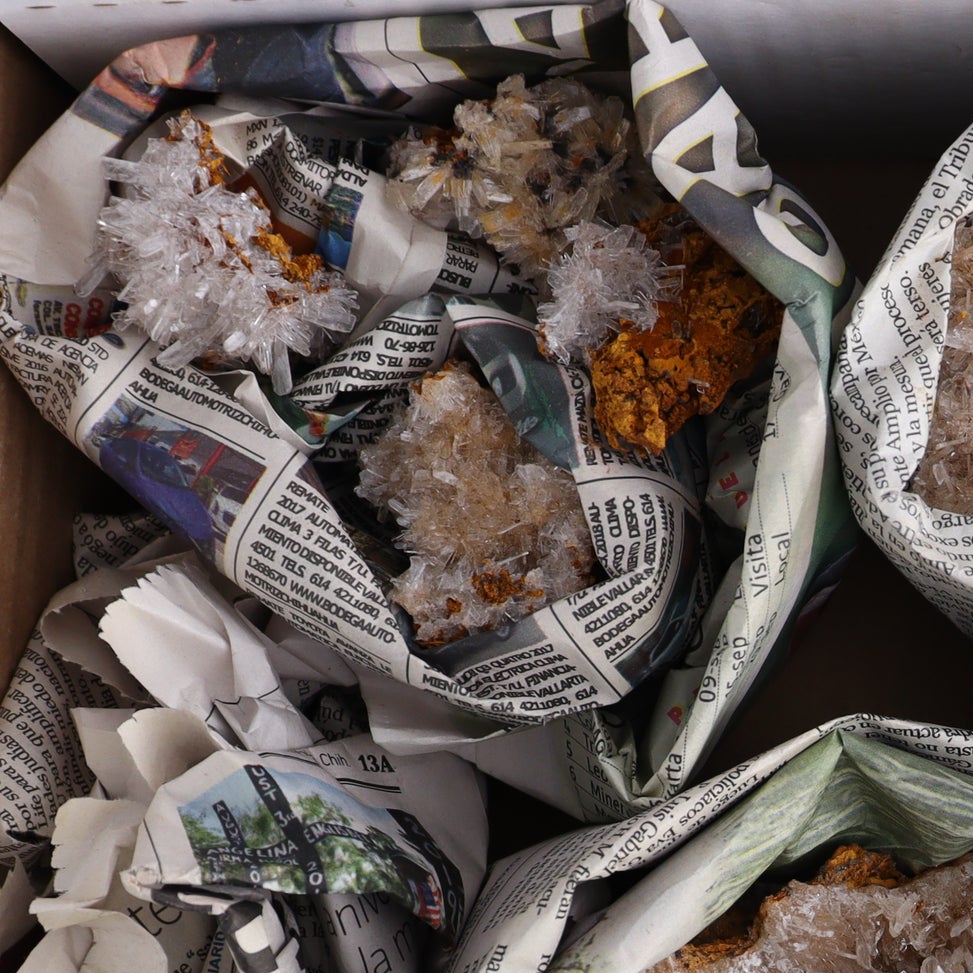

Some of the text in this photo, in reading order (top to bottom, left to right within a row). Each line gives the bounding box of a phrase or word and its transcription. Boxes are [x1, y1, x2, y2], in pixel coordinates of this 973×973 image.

[276, 494, 307, 515] 2017
[286, 481, 330, 514] REMATE
[257, 523, 365, 593] MIENTO DISPONIBLE
[267, 509, 347, 560] CLIMA 3 FILAS
[250, 540, 331, 591] 4501 614
[746, 533, 769, 598] Visita
[357, 754, 396, 773] 13A
